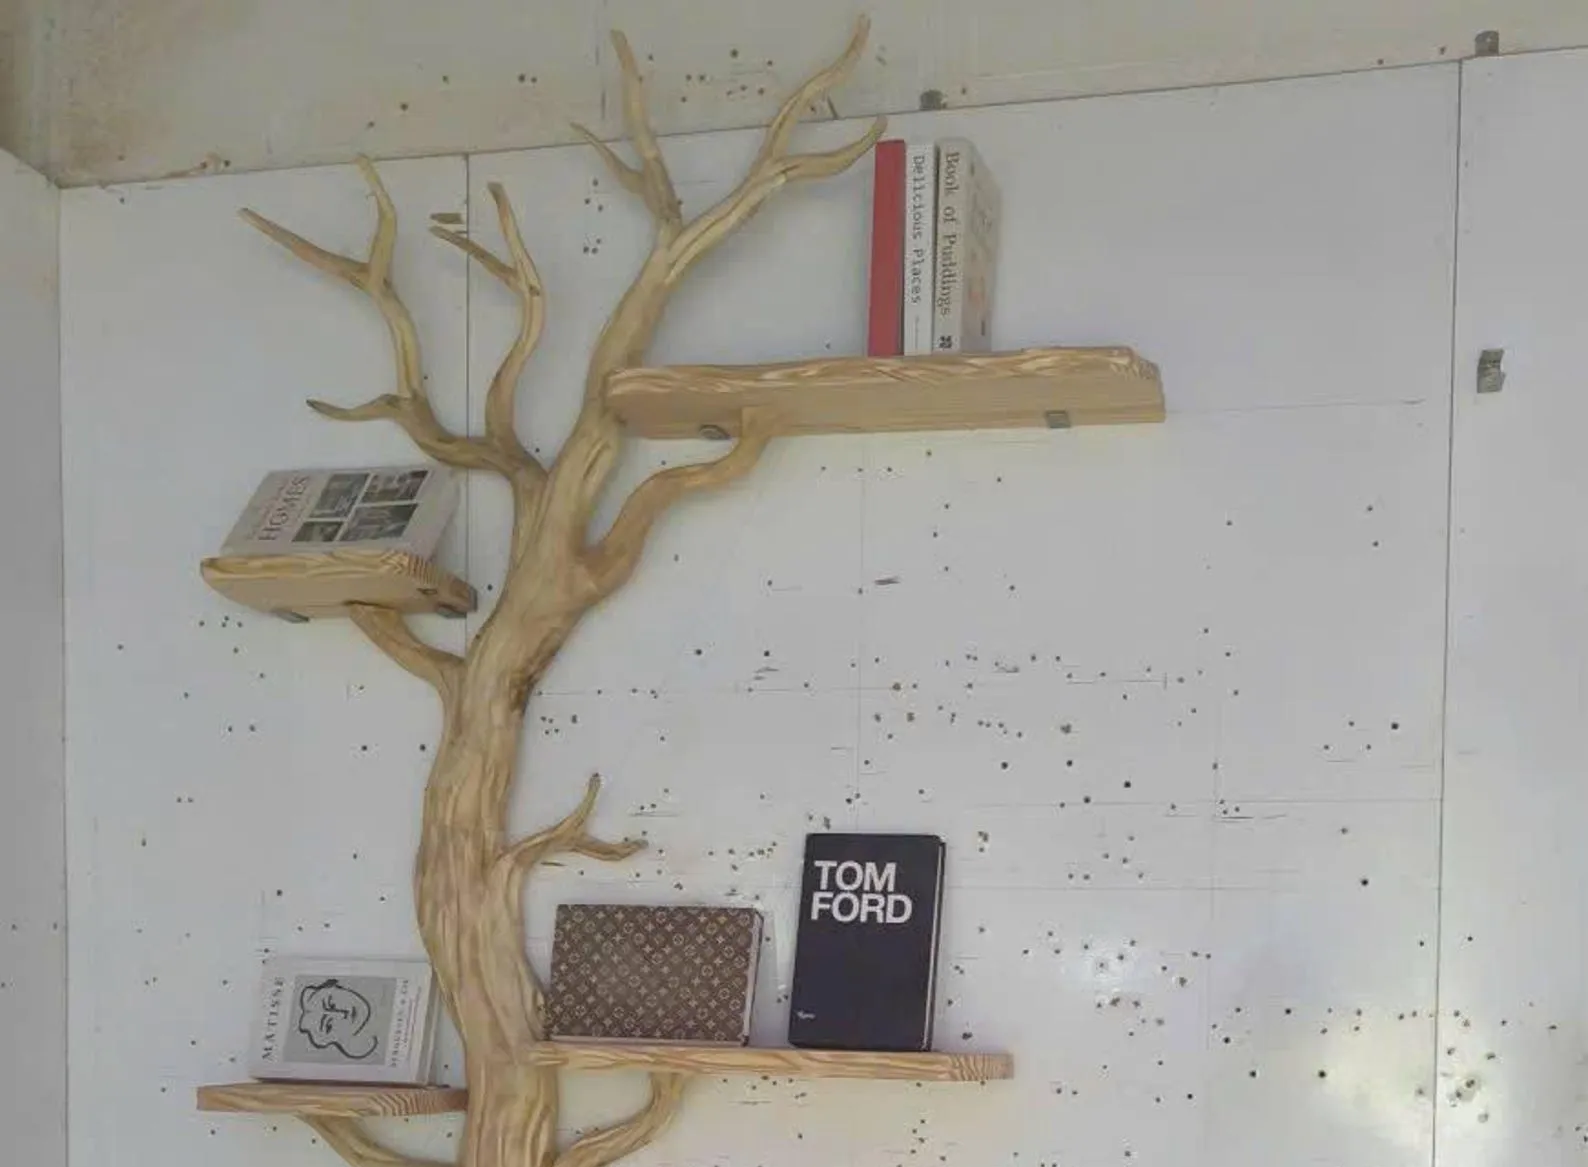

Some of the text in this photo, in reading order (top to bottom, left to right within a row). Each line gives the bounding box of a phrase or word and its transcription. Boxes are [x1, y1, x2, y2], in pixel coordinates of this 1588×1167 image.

[911, 155, 925, 240] Delicious
[936, 152, 959, 316] Book of Puddings
[911, 248, 925, 304] Places
[814, 860, 897, 893] TOM
[810, 892, 913, 924] FORD
